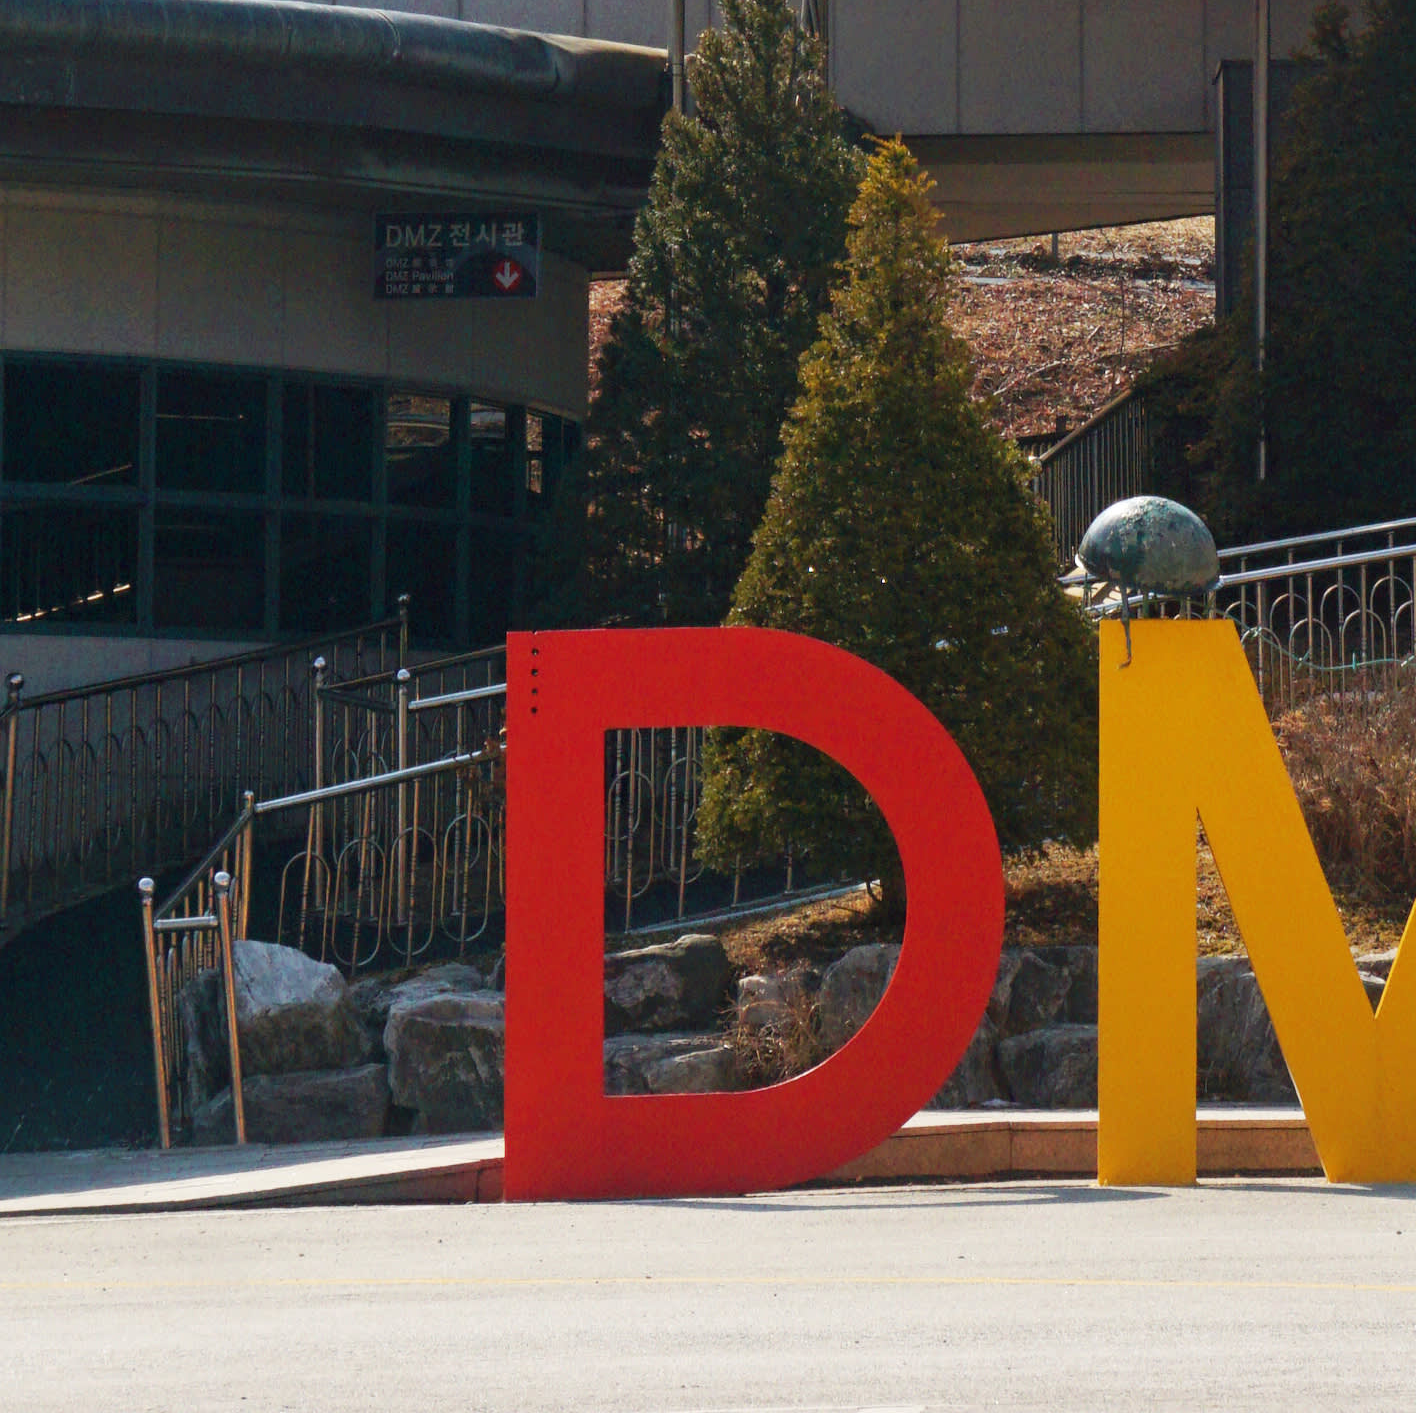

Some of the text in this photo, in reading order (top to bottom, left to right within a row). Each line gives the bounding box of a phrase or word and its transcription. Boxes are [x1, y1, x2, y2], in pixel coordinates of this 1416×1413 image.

[386, 221, 525, 249] DMZ 전시관
[386, 258, 409, 269] DMZ
[386, 285, 409, 294] DMZ
